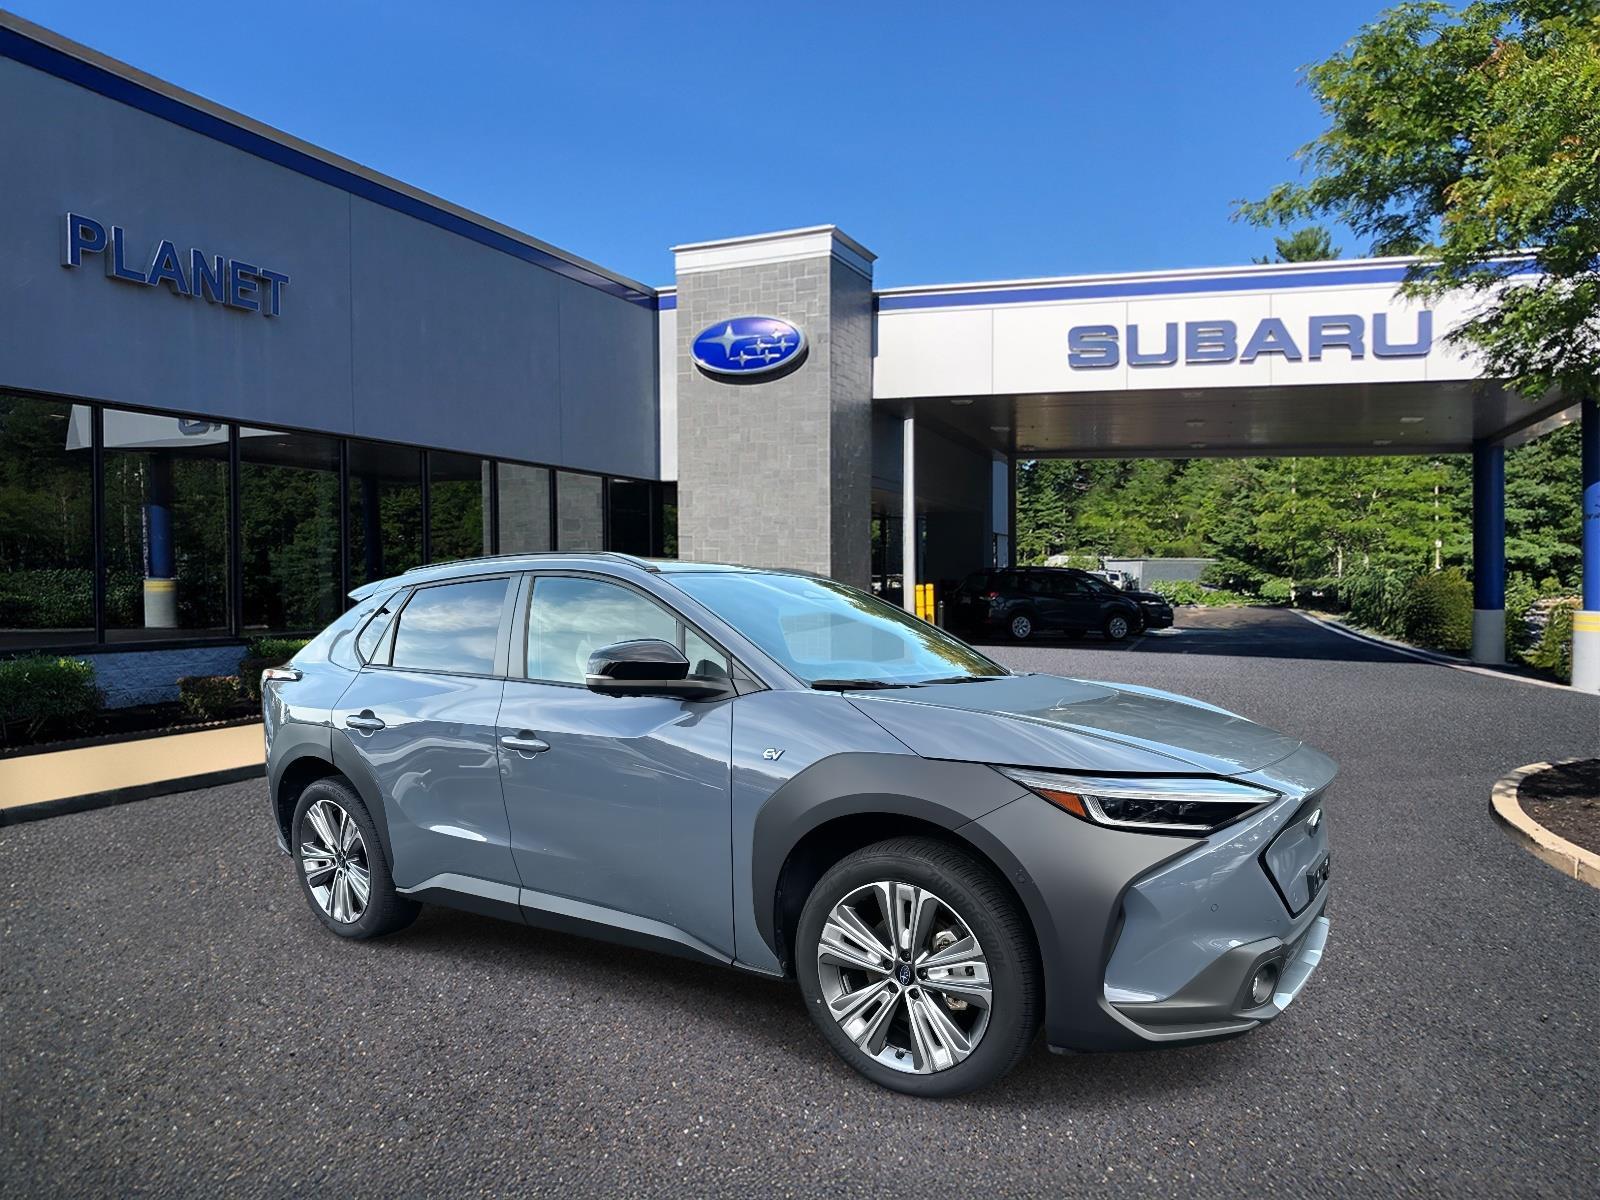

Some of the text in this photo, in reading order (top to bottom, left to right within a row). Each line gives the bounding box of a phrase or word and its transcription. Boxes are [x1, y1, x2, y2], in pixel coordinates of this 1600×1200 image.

[65, 212, 291, 317] PLANET
[1068, 309, 1433, 370] SUBARU
[762, 747, 786, 761] EV
